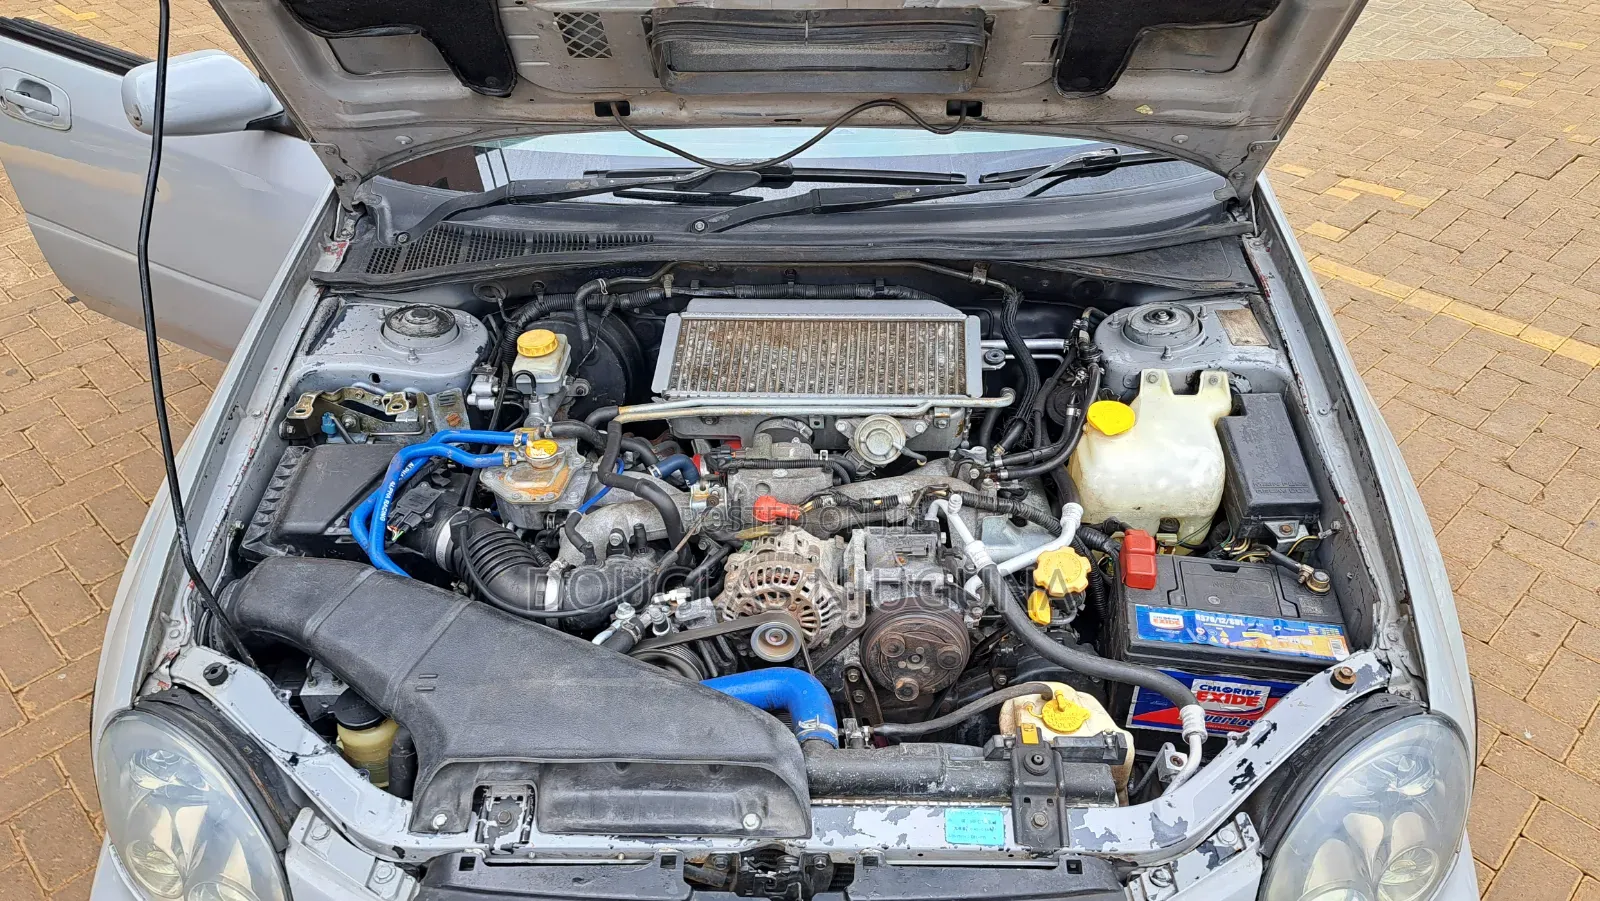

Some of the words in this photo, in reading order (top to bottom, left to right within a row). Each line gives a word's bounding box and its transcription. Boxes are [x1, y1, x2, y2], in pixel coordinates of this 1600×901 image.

[384, 480, 396, 499] ALPHA
[380, 499, 390, 522] RACING
[1196, 690, 1262, 707] EXIDE
[1199, 684, 1262, 697] CHLORIDE
